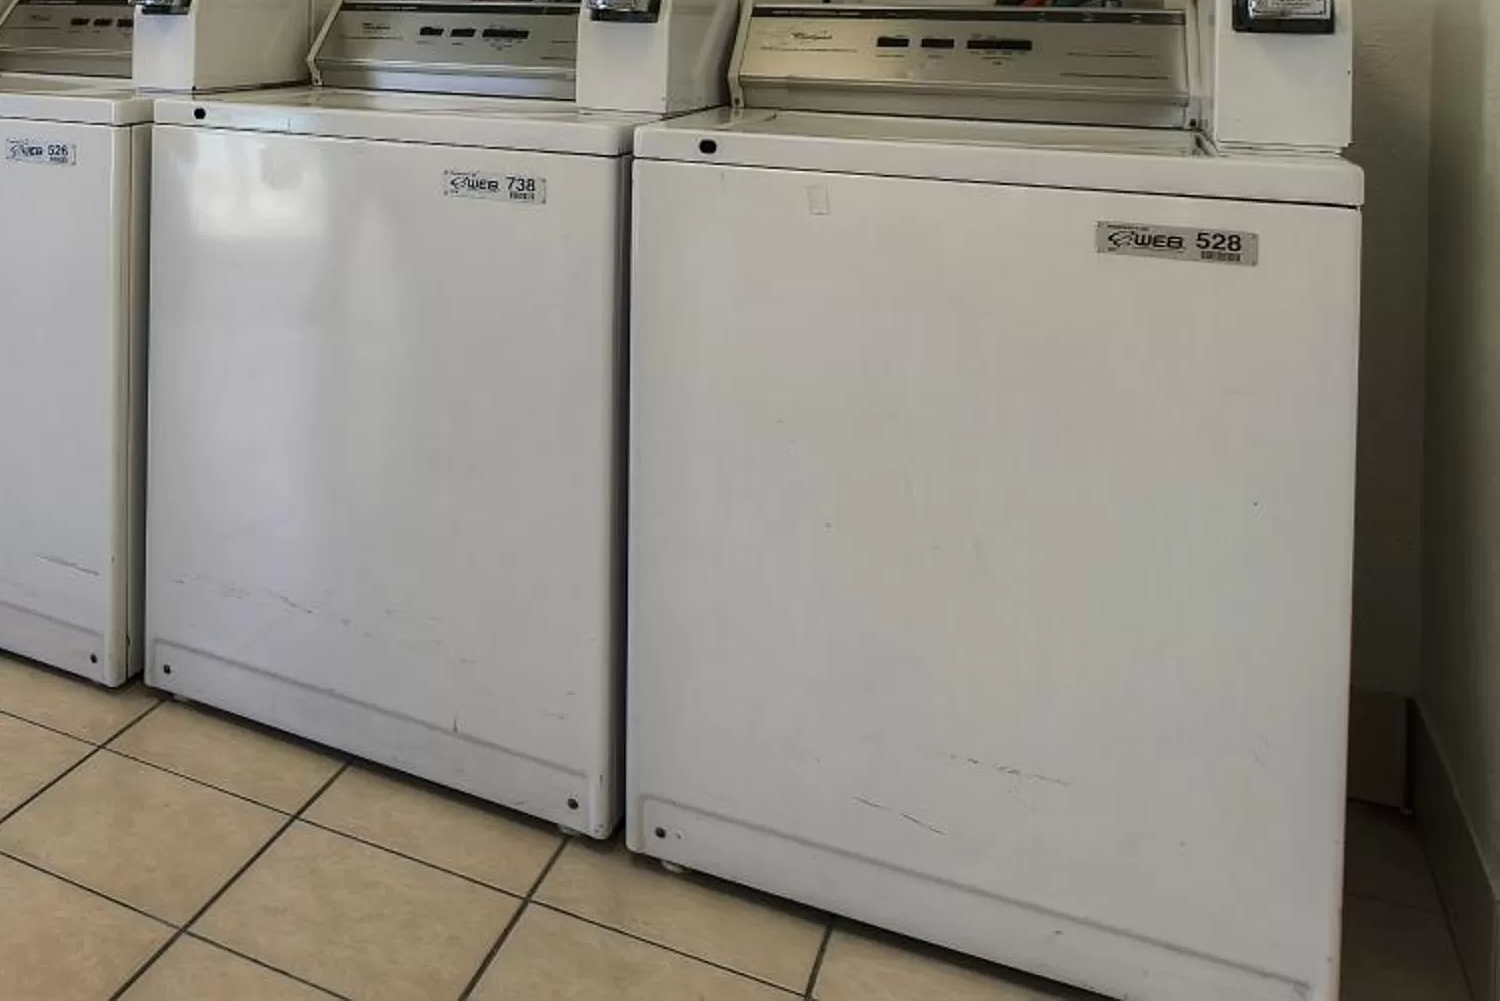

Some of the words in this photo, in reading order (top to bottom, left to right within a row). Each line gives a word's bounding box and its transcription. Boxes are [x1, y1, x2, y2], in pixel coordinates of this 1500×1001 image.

[506, 176, 536, 192] 738
[1133, 233, 1185, 250] WEB
[1195, 231, 1243, 252] 528
